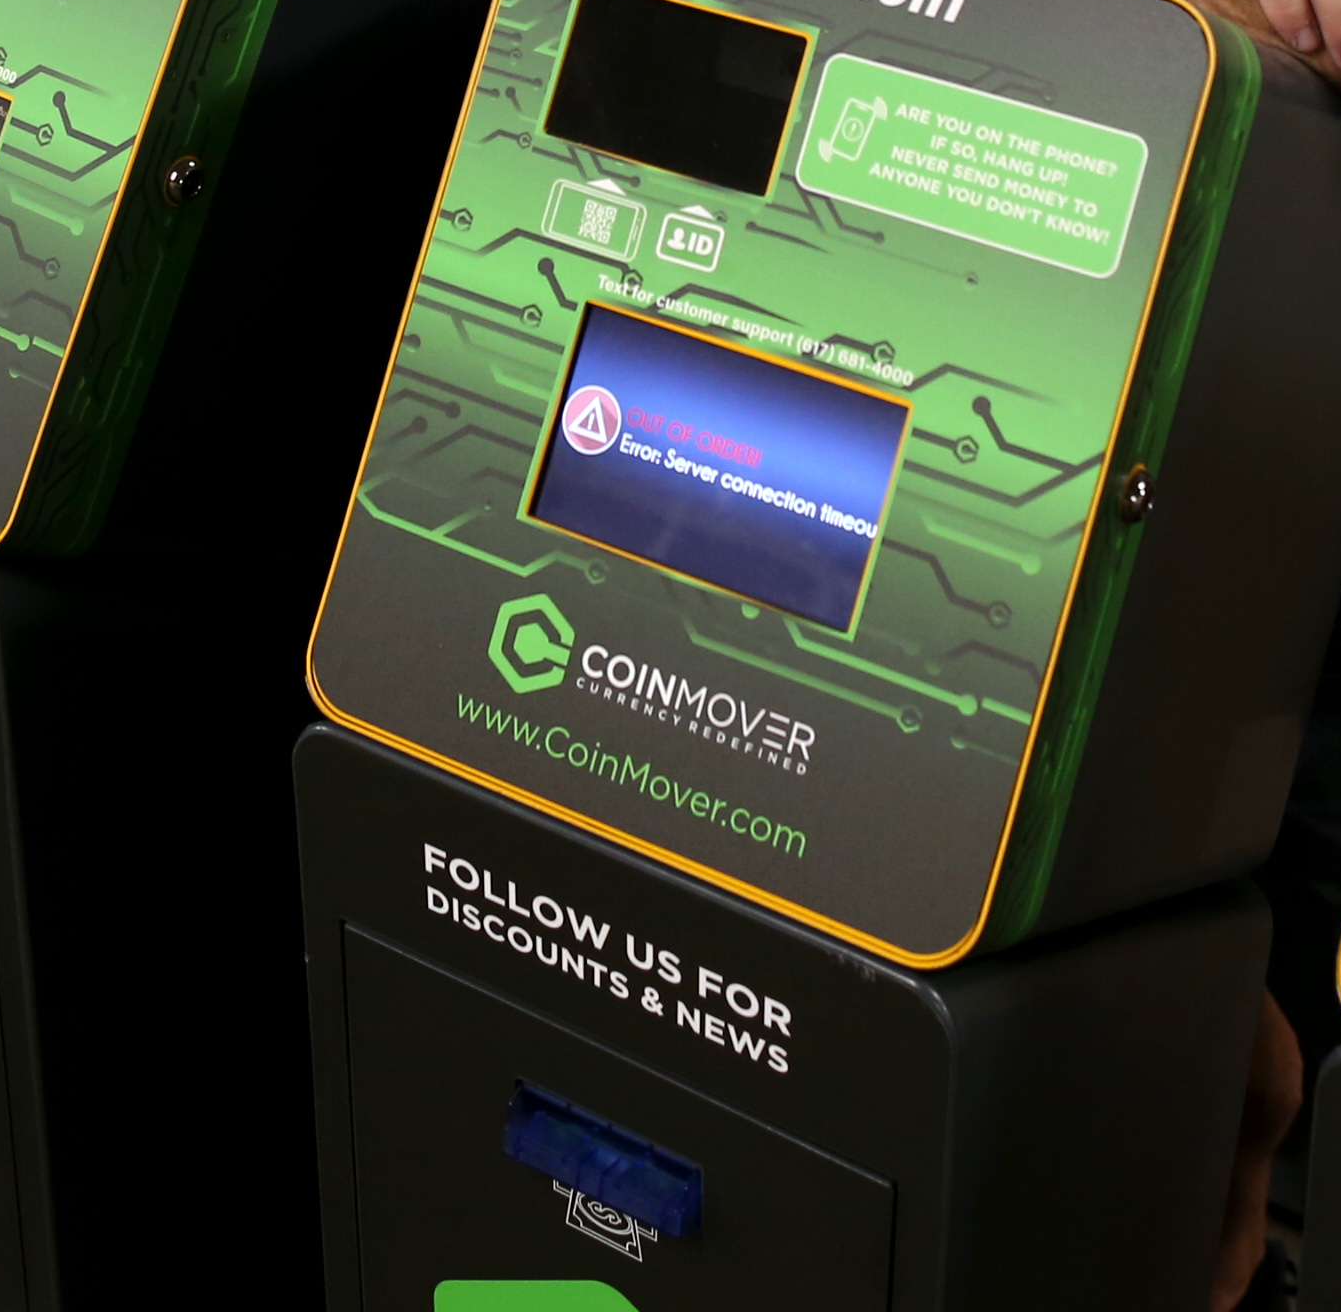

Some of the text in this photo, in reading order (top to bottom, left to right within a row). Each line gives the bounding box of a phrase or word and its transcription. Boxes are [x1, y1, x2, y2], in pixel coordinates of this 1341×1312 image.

[891, 145, 1098, 218] NEVER SEND MONEY TO
[895, 103, 1118, 176] ARE YOU ON THE PHONE?
[929, 134, 1069, 186] IF SO, HANG UP!
[687, 232, 714, 255] ID
[868, 162, 1110, 242] ANYONE YOU DON'T KNOW!
[598, 273, 914, 386] Text for customer support (617) 681-4000
[619, 432, 662, 465] Error:
[663, 447, 719, 484] Server
[720, 472, 817, 519] connection
[626, 407, 762, 467] OUT OF ORDER!
[575, 676, 807, 775] CURRENCY REDEFINED
[581, 644, 815, 761] COINMOVER
[458, 693, 806, 858] www.CoinMover.com
[424, 843, 792, 1036] FOLLOW US FOR
[427, 885, 789, 1074] DISCOUNTS & NEWS
